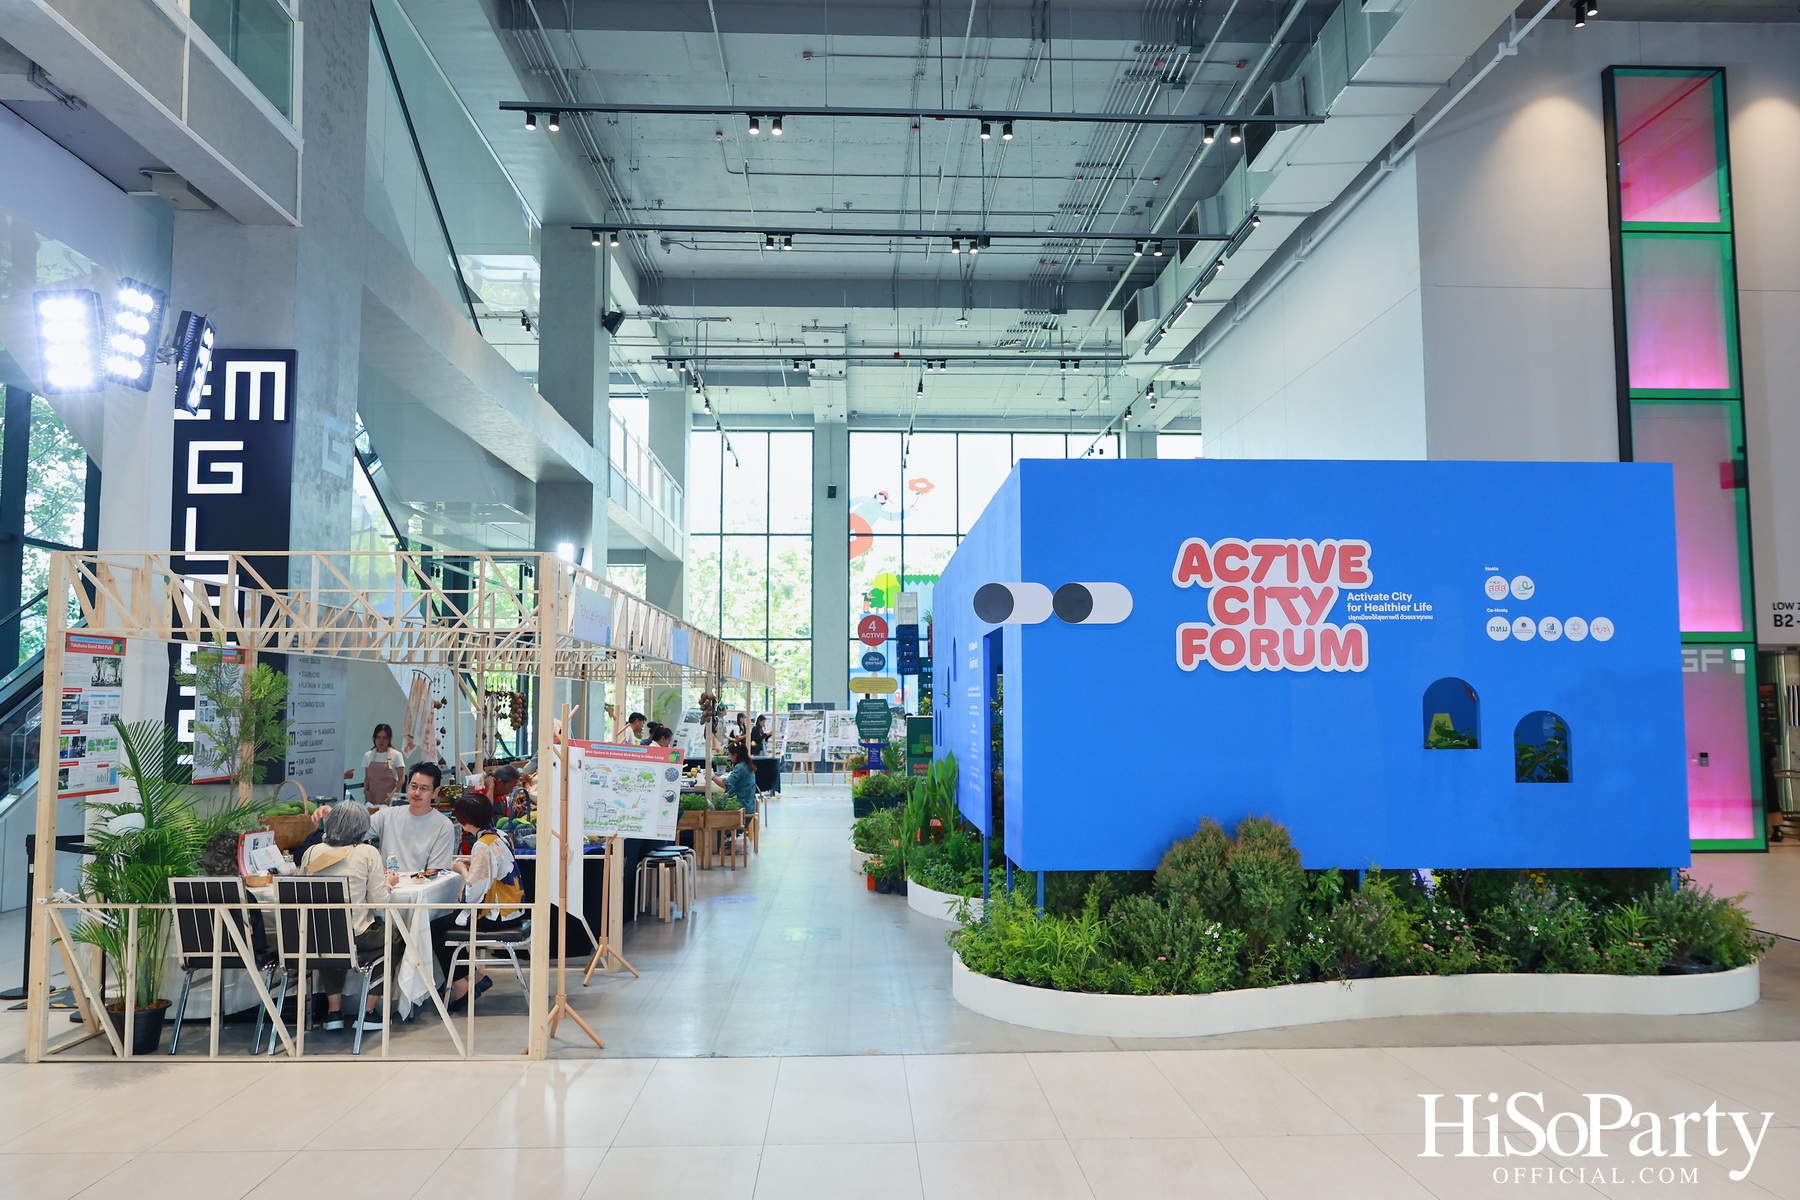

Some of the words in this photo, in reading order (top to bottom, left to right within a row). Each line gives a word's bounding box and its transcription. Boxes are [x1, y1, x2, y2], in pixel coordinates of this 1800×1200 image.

[1177, 542, 1368, 584] ACTIVE
[1347, 592, 1390, 601] Activate
[1391, 592, 1412, 602] City
[1212, 586, 1334, 626] CITY
[1347, 602, 1362, 612] for
[1364, 602, 1412, 612] Healthier
[1413, 602, 1433, 612] Life
[1772, 602, 1795, 610] LOW
[868, 620, 877, 631] 4
[1774, 614, 1794, 627] B2
[1181, 628, 1363, 666] FORUM
[288, 762, 295, 775] G
